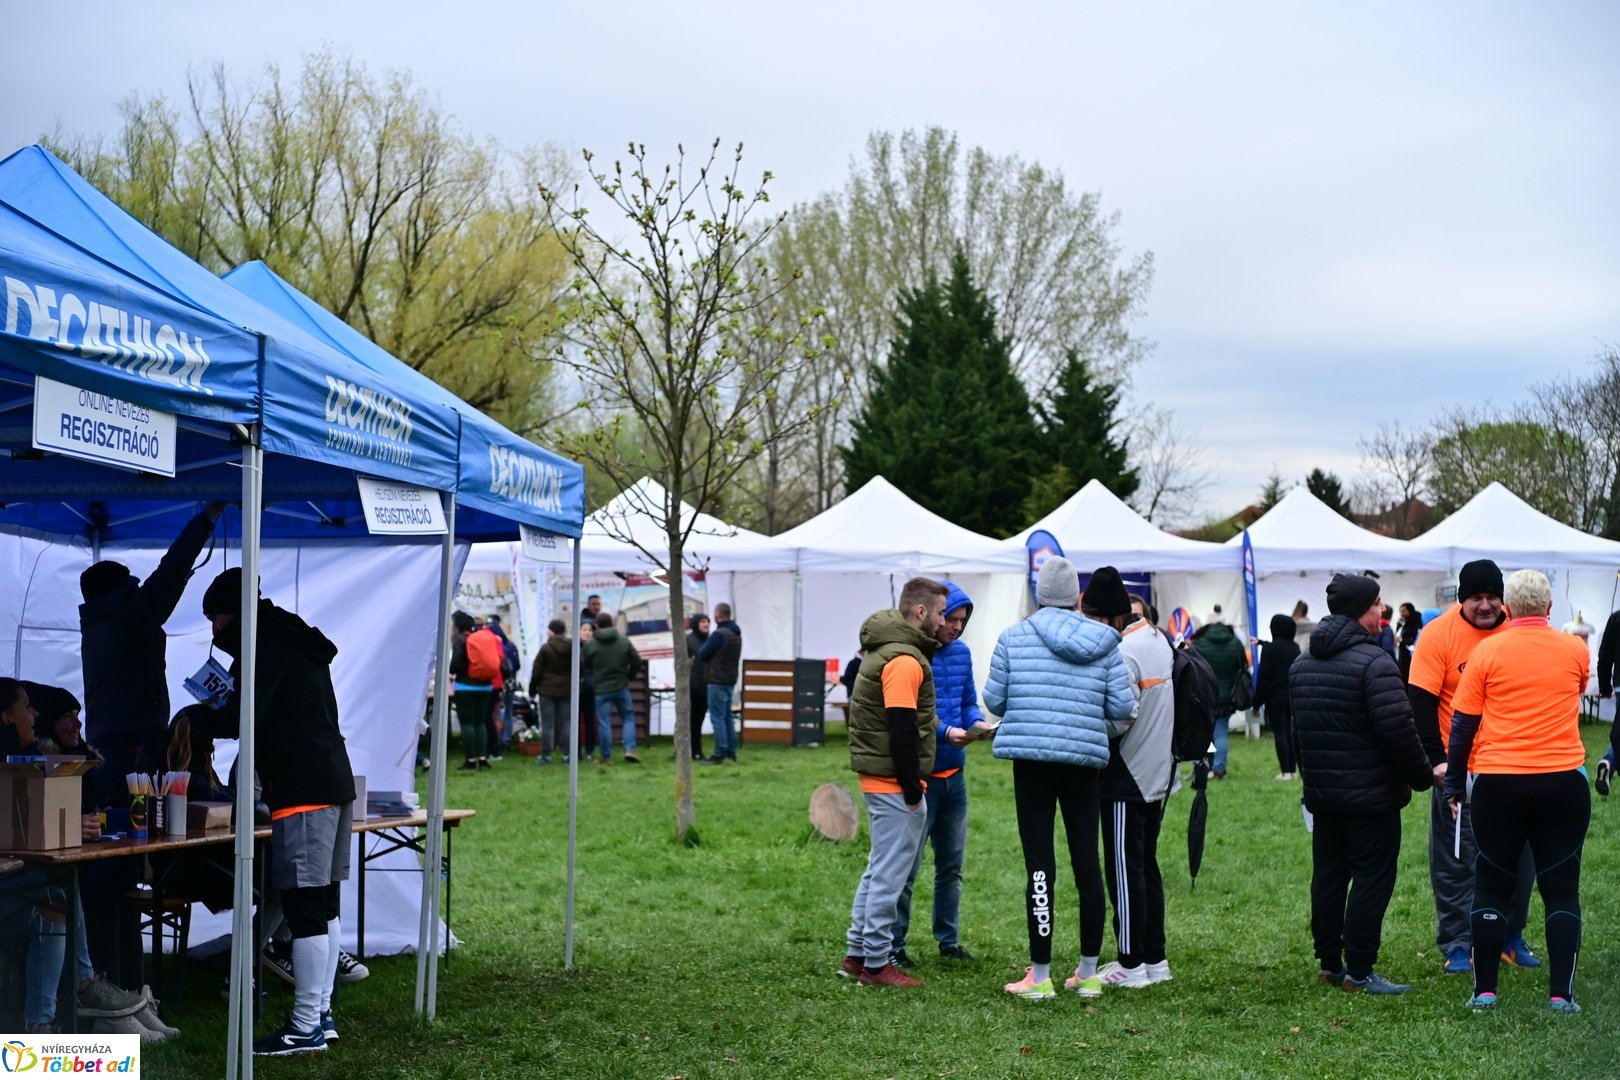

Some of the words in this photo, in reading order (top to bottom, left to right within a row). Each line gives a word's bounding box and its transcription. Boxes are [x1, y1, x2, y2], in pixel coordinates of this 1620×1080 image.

[4, 276, 214, 396] DECATHLON
[78, 389, 114, 414] ONLINE
[325, 375, 413, 445] DECATHLON
[60, 413, 159, 459] REGISZTRÁCIÓ
[489, 443, 563, 515] DECATHLON
[374, 504, 432, 525] REGISZTRÁCIÓ
[1031, 870, 1051, 937] adidas
